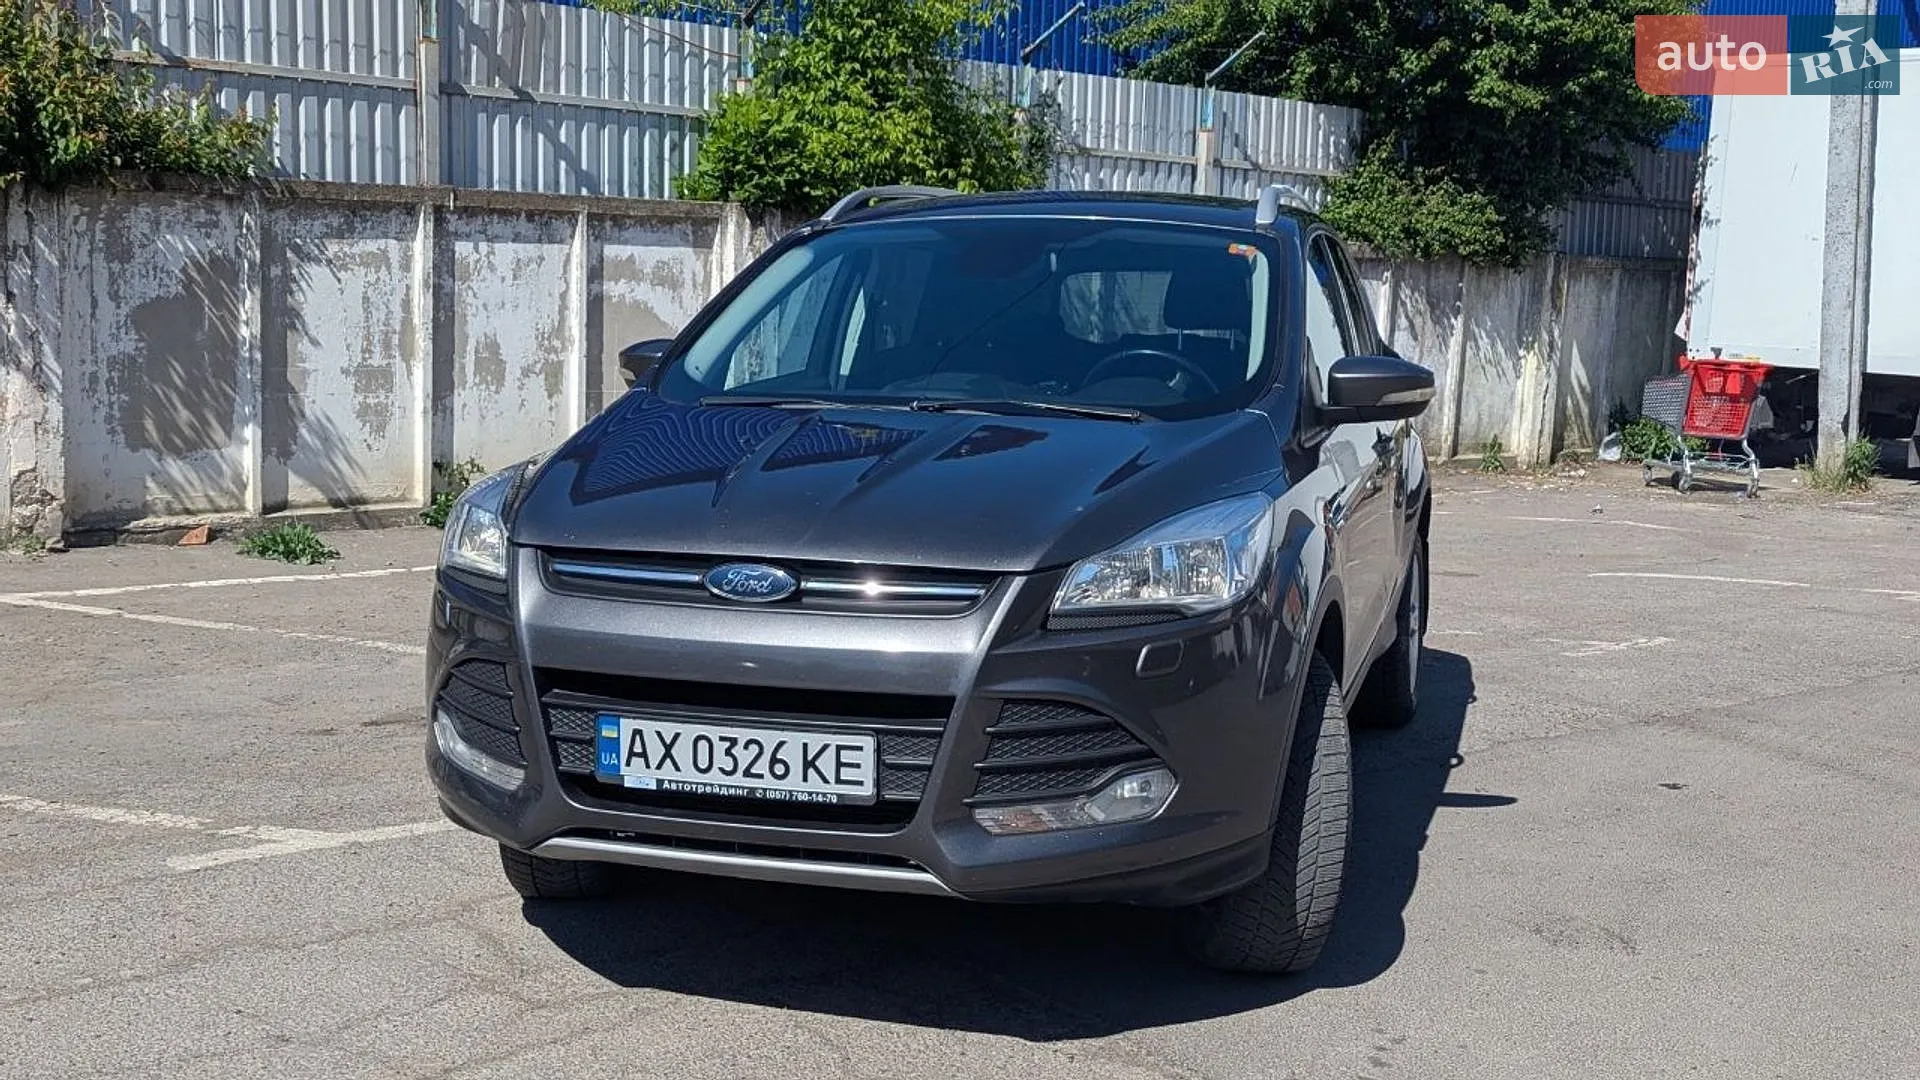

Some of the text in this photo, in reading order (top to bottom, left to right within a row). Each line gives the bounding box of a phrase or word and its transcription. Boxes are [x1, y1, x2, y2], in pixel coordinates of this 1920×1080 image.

[722, 568, 774, 593] Ford
[601, 752, 618, 765] UA
[625, 728, 865, 787] AX 0326 KE
[662, 780, 838, 803] Автотрейдинг (057) 760-14-70
